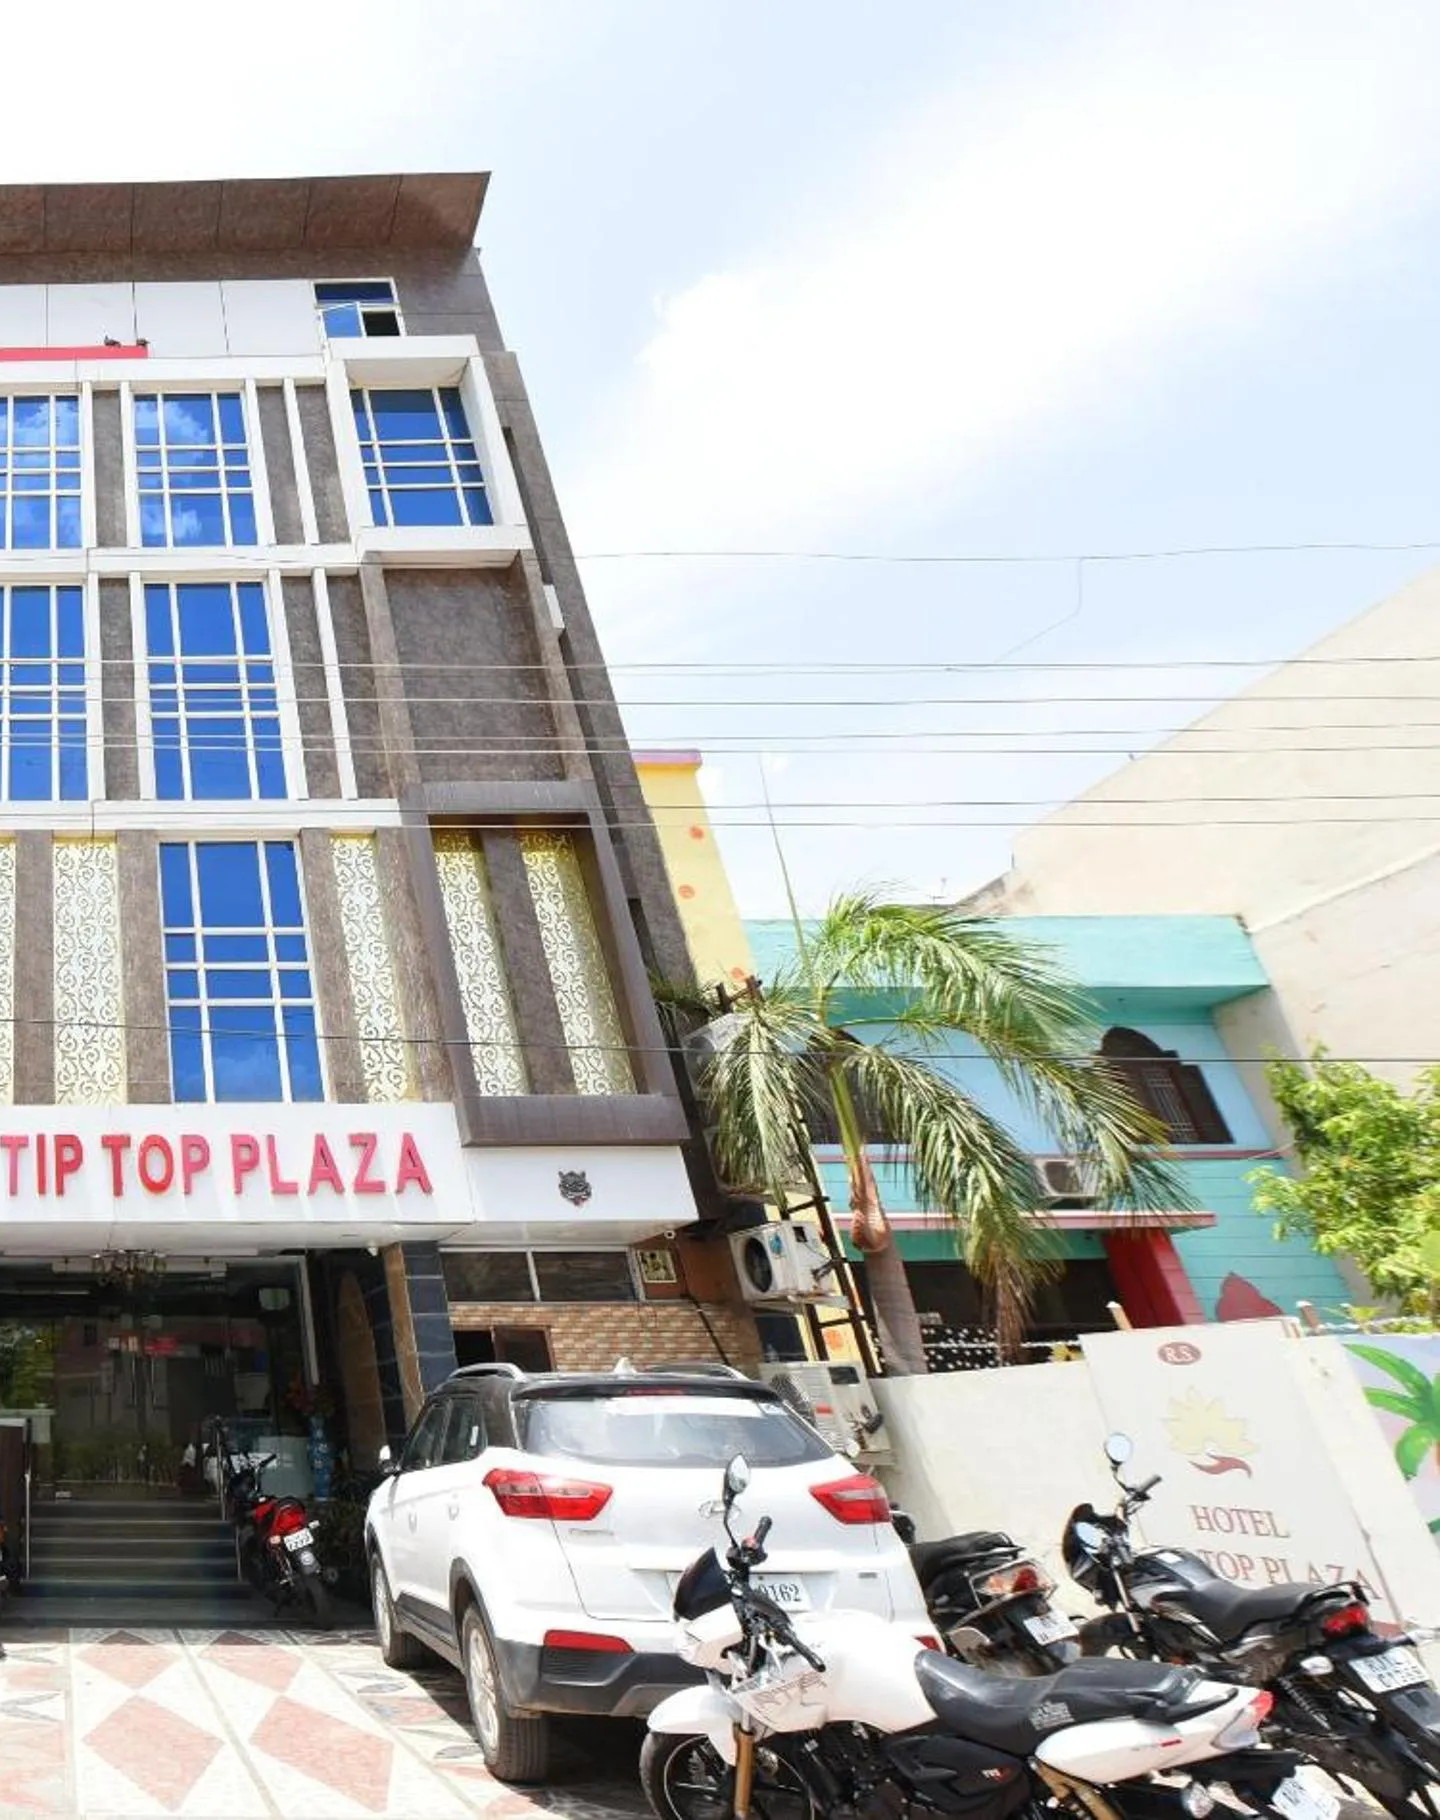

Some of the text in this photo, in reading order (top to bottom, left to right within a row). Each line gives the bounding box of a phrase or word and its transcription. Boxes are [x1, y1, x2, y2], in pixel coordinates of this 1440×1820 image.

[0, 1134, 84, 1198] TIP
[102, 1134, 212, 1198] TOP
[231, 1131, 434, 1196] PLAZA
[1189, 1505, 1291, 1538] HOTEL
